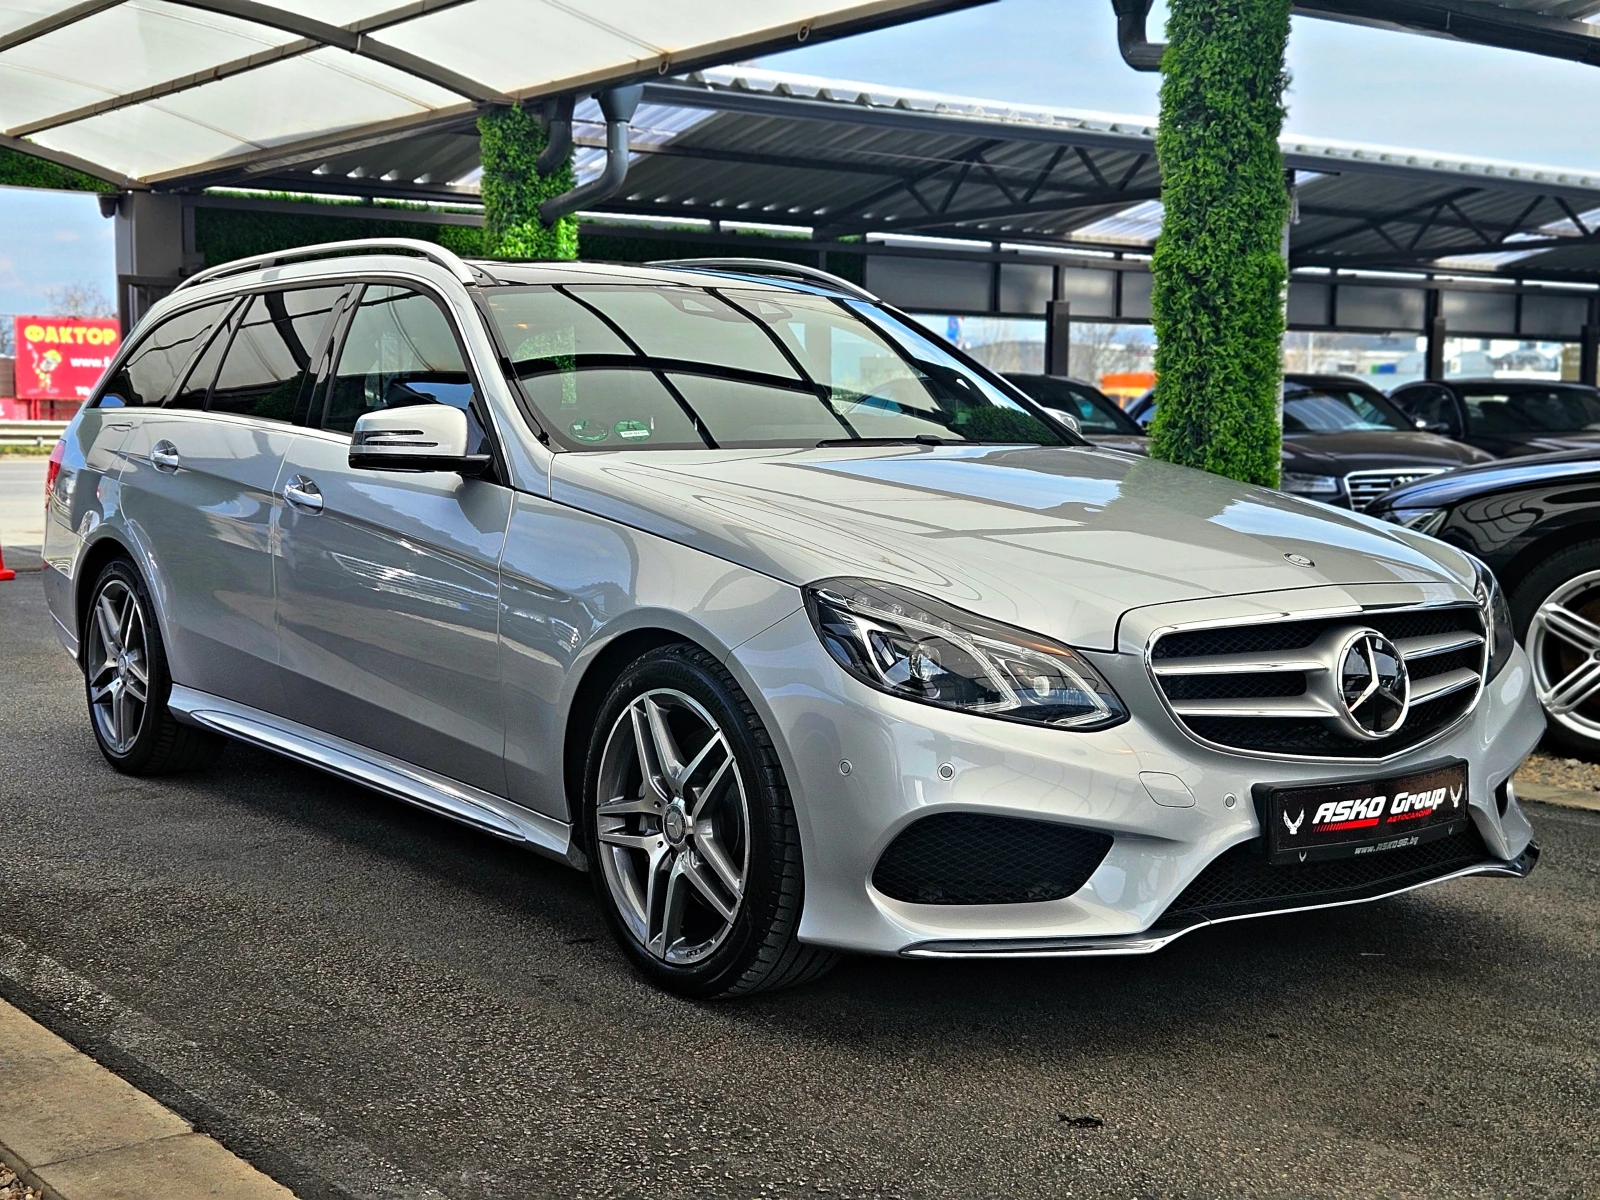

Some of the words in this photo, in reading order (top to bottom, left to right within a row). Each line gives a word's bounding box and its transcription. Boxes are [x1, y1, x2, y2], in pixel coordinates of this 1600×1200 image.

[24, 324, 117, 345] ФАКТОР
[1312, 796, 1387, 824] ASKO
[1390, 787, 1447, 815] Group
